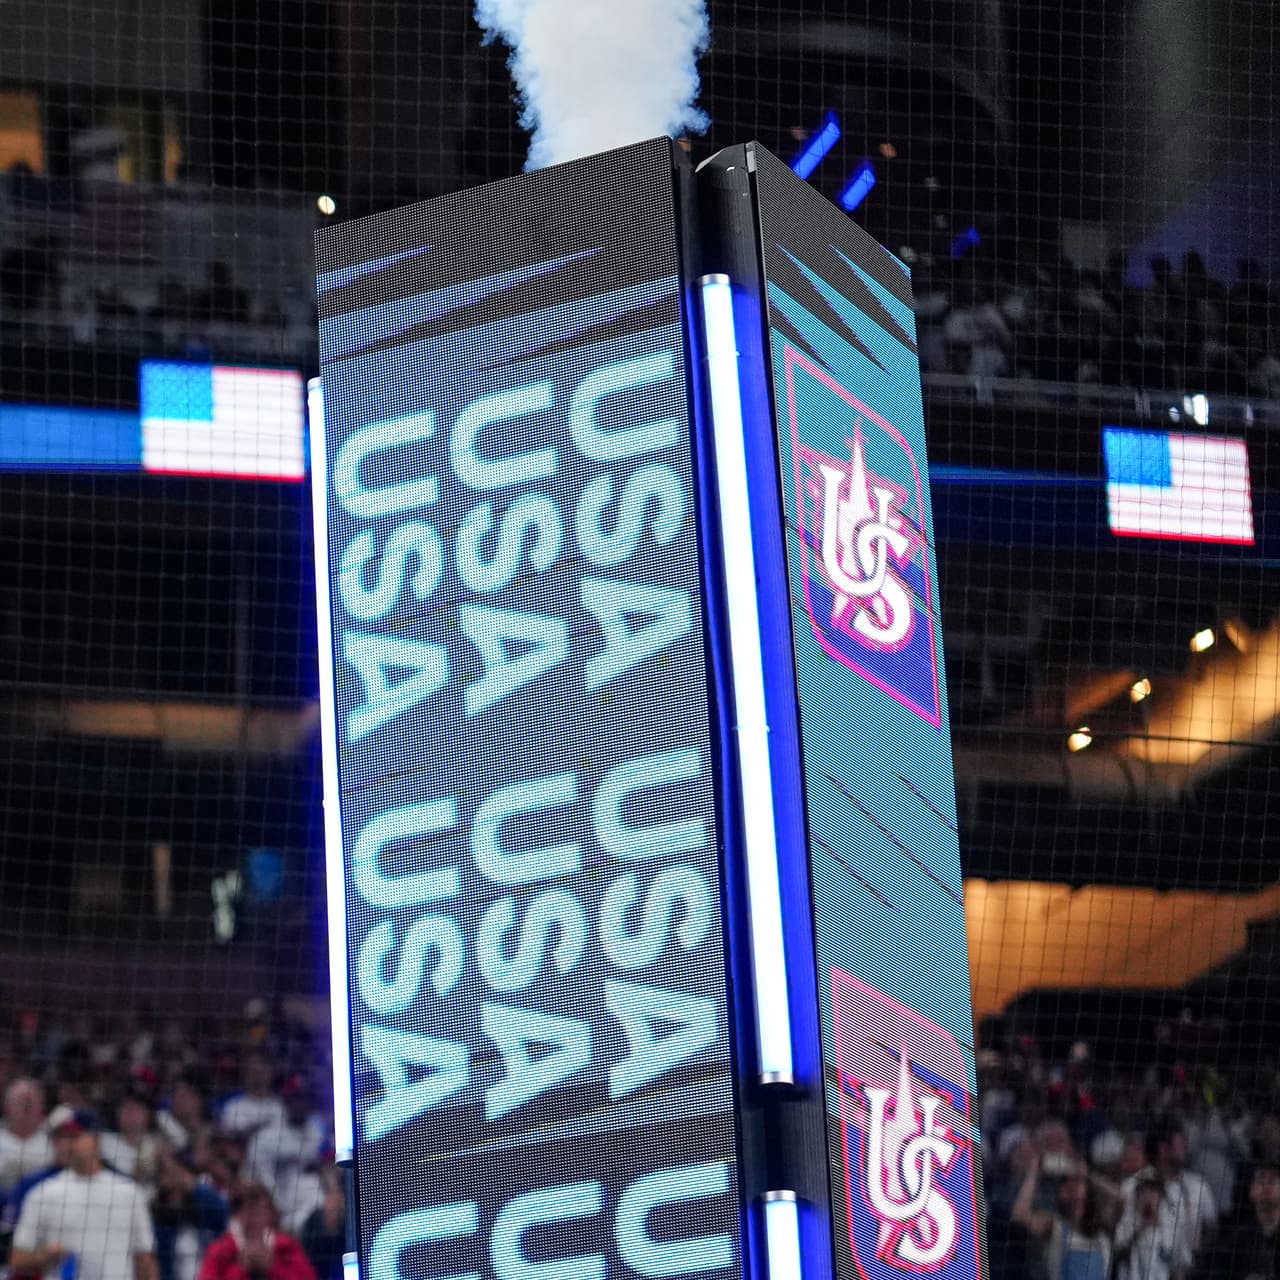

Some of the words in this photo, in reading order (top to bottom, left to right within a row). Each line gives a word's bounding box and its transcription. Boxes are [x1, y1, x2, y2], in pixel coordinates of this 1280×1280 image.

[334, 408, 450, 743] USA
[450, 379, 570, 716] USA
[569, 350, 693, 692] USA
[352, 798, 470, 1140] USA
[471, 771, 592, 1119] USA
[591, 746, 719, 1096] USA
